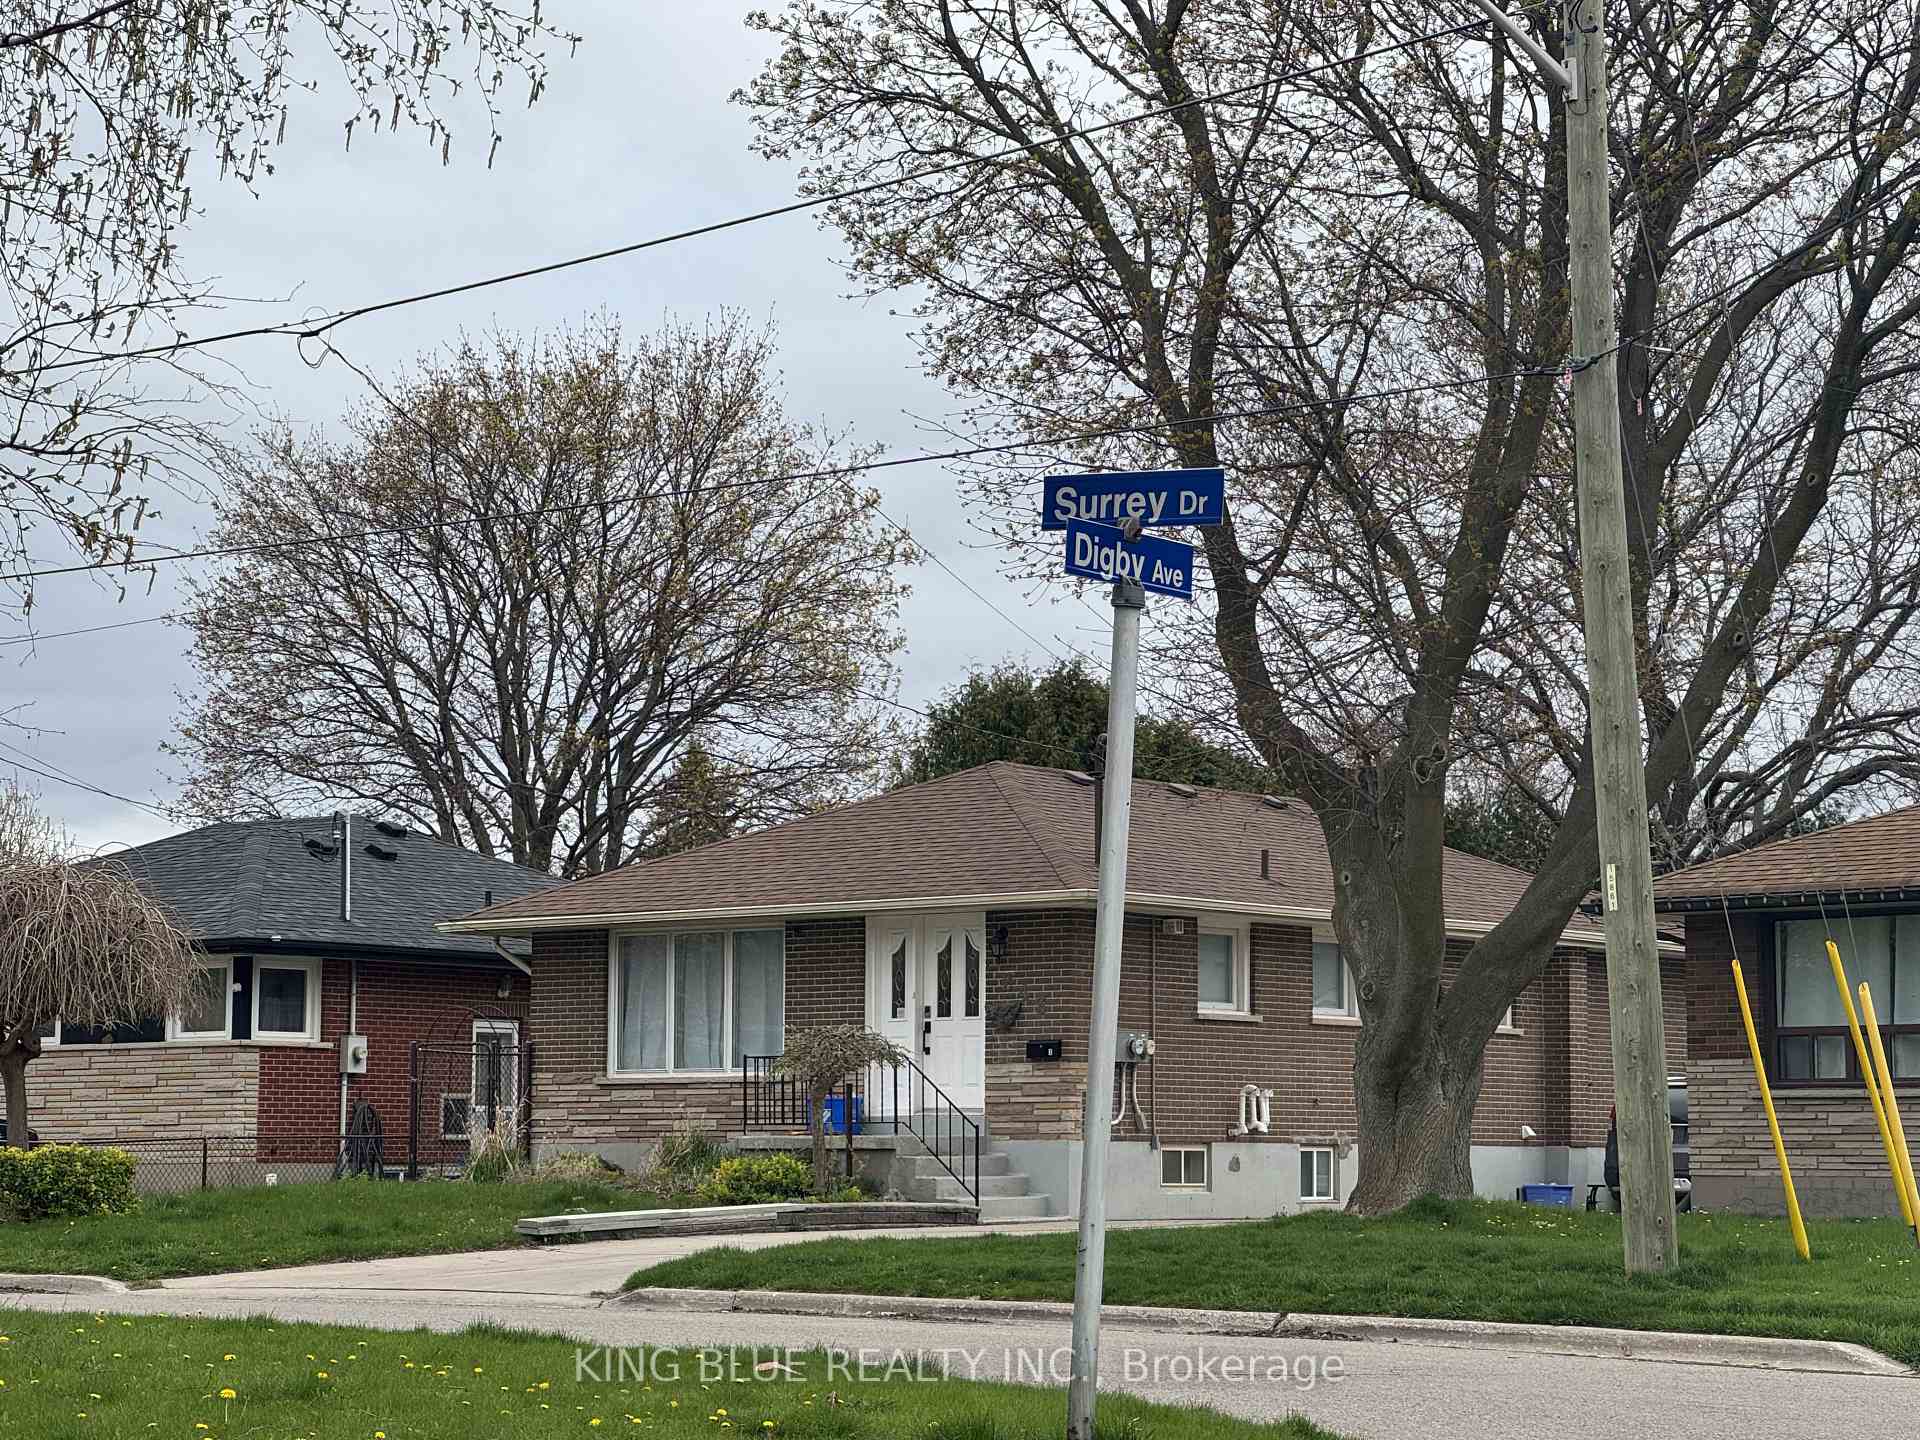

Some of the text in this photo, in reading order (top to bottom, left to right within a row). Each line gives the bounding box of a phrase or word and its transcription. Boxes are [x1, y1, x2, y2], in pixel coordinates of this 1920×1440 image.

[1054, 486, 1208, 523] Surrey Dr
[1074, 532, 1184, 588] Digby Ave
